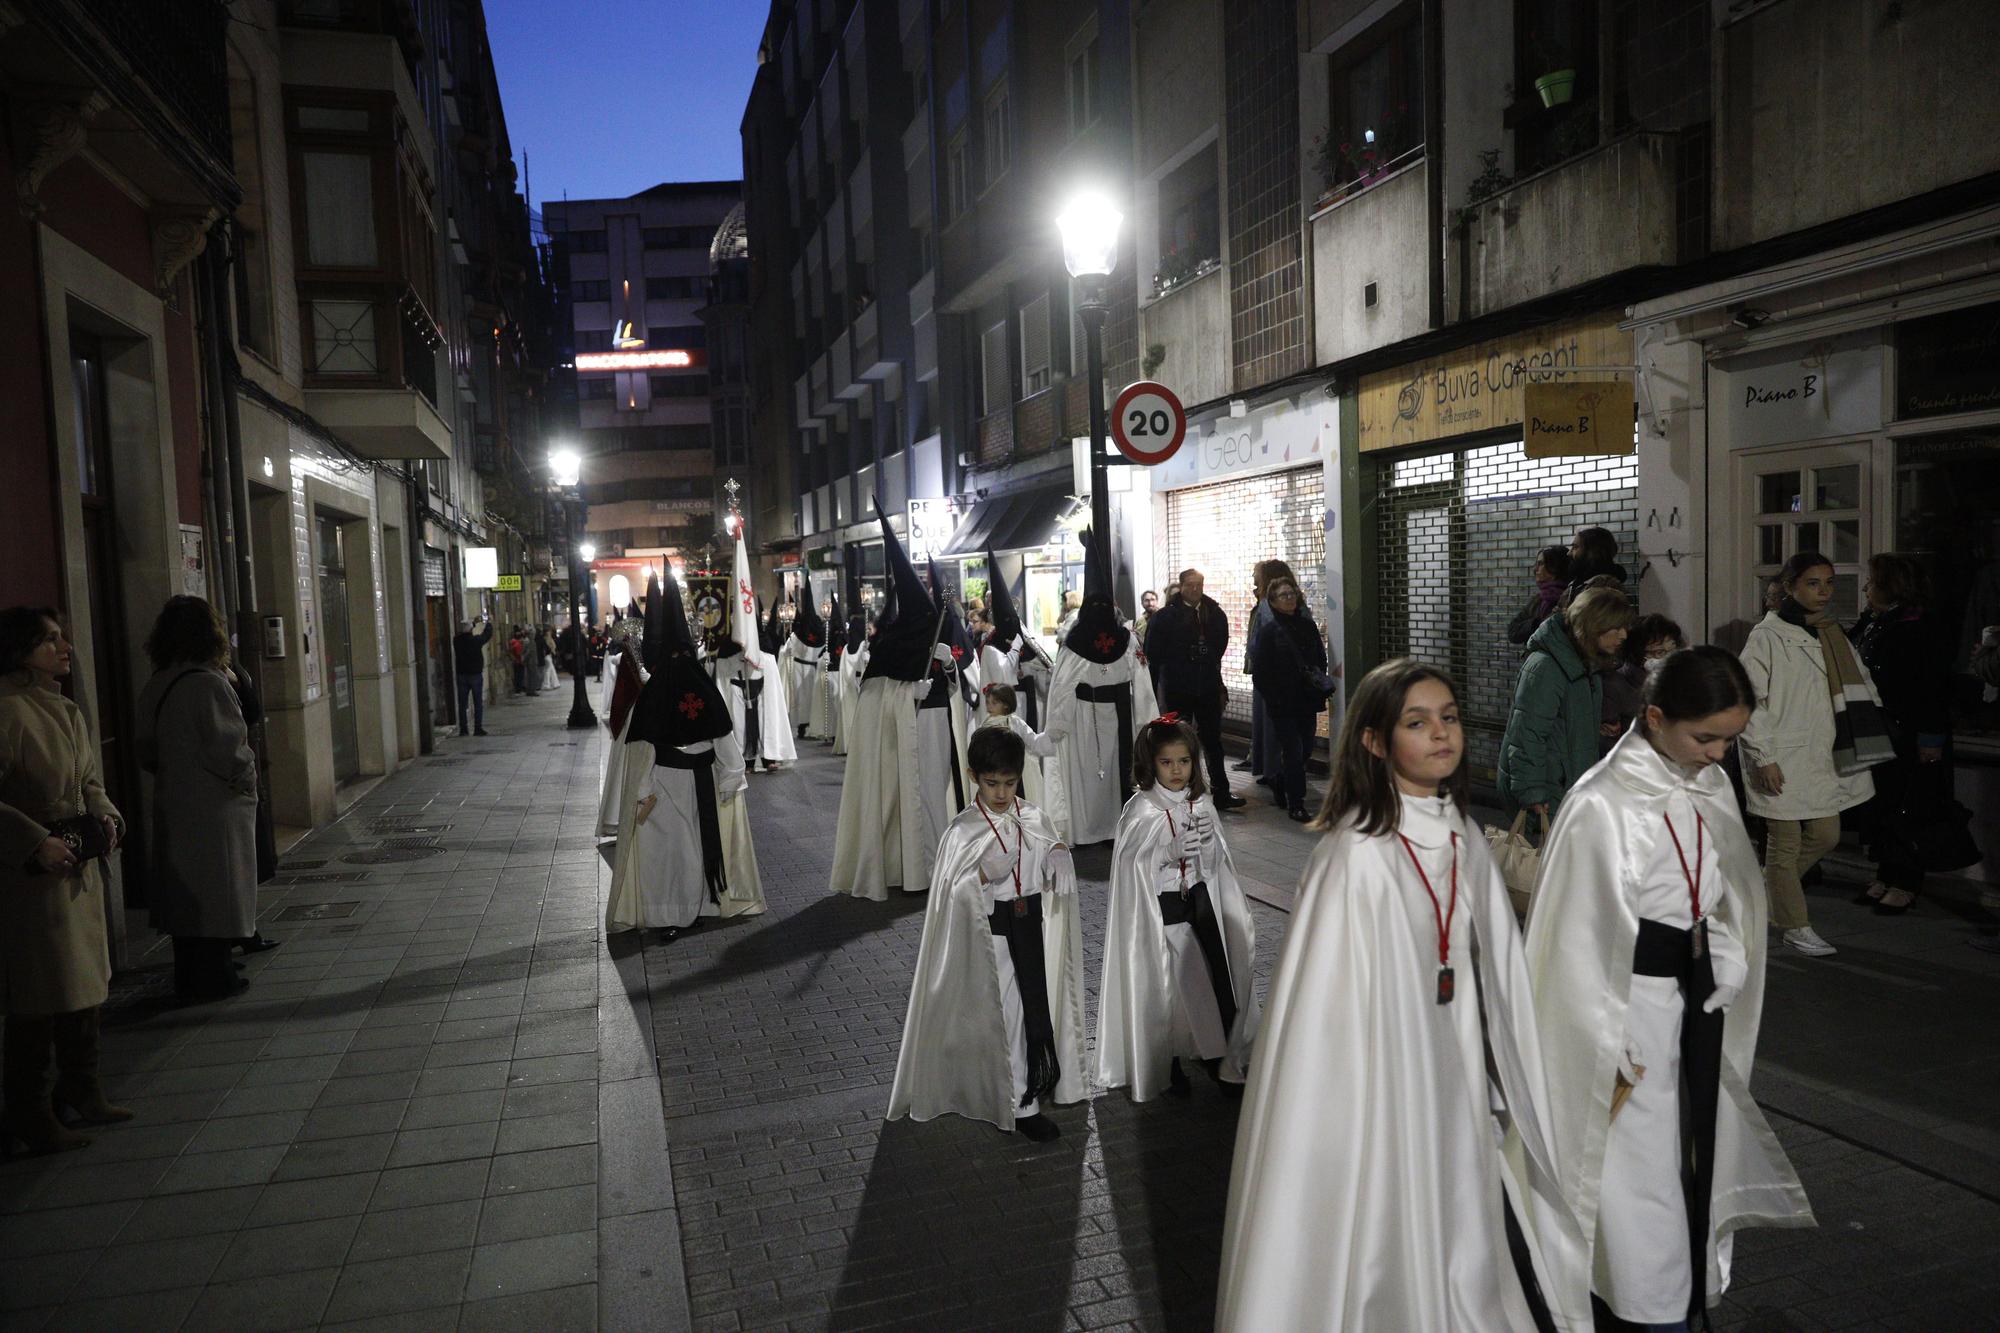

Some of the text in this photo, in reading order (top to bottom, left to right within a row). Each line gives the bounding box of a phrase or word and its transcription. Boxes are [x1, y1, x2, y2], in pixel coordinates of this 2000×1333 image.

[1437, 337, 1578, 404] Buva Concept
[1745, 374, 1817, 408] Piano B
[1129, 410, 1169, 437] 20
[1532, 416, 1590, 436] Piano B
[1205, 430, 1253, 470] Gea
[913, 526, 947, 539] QUE
